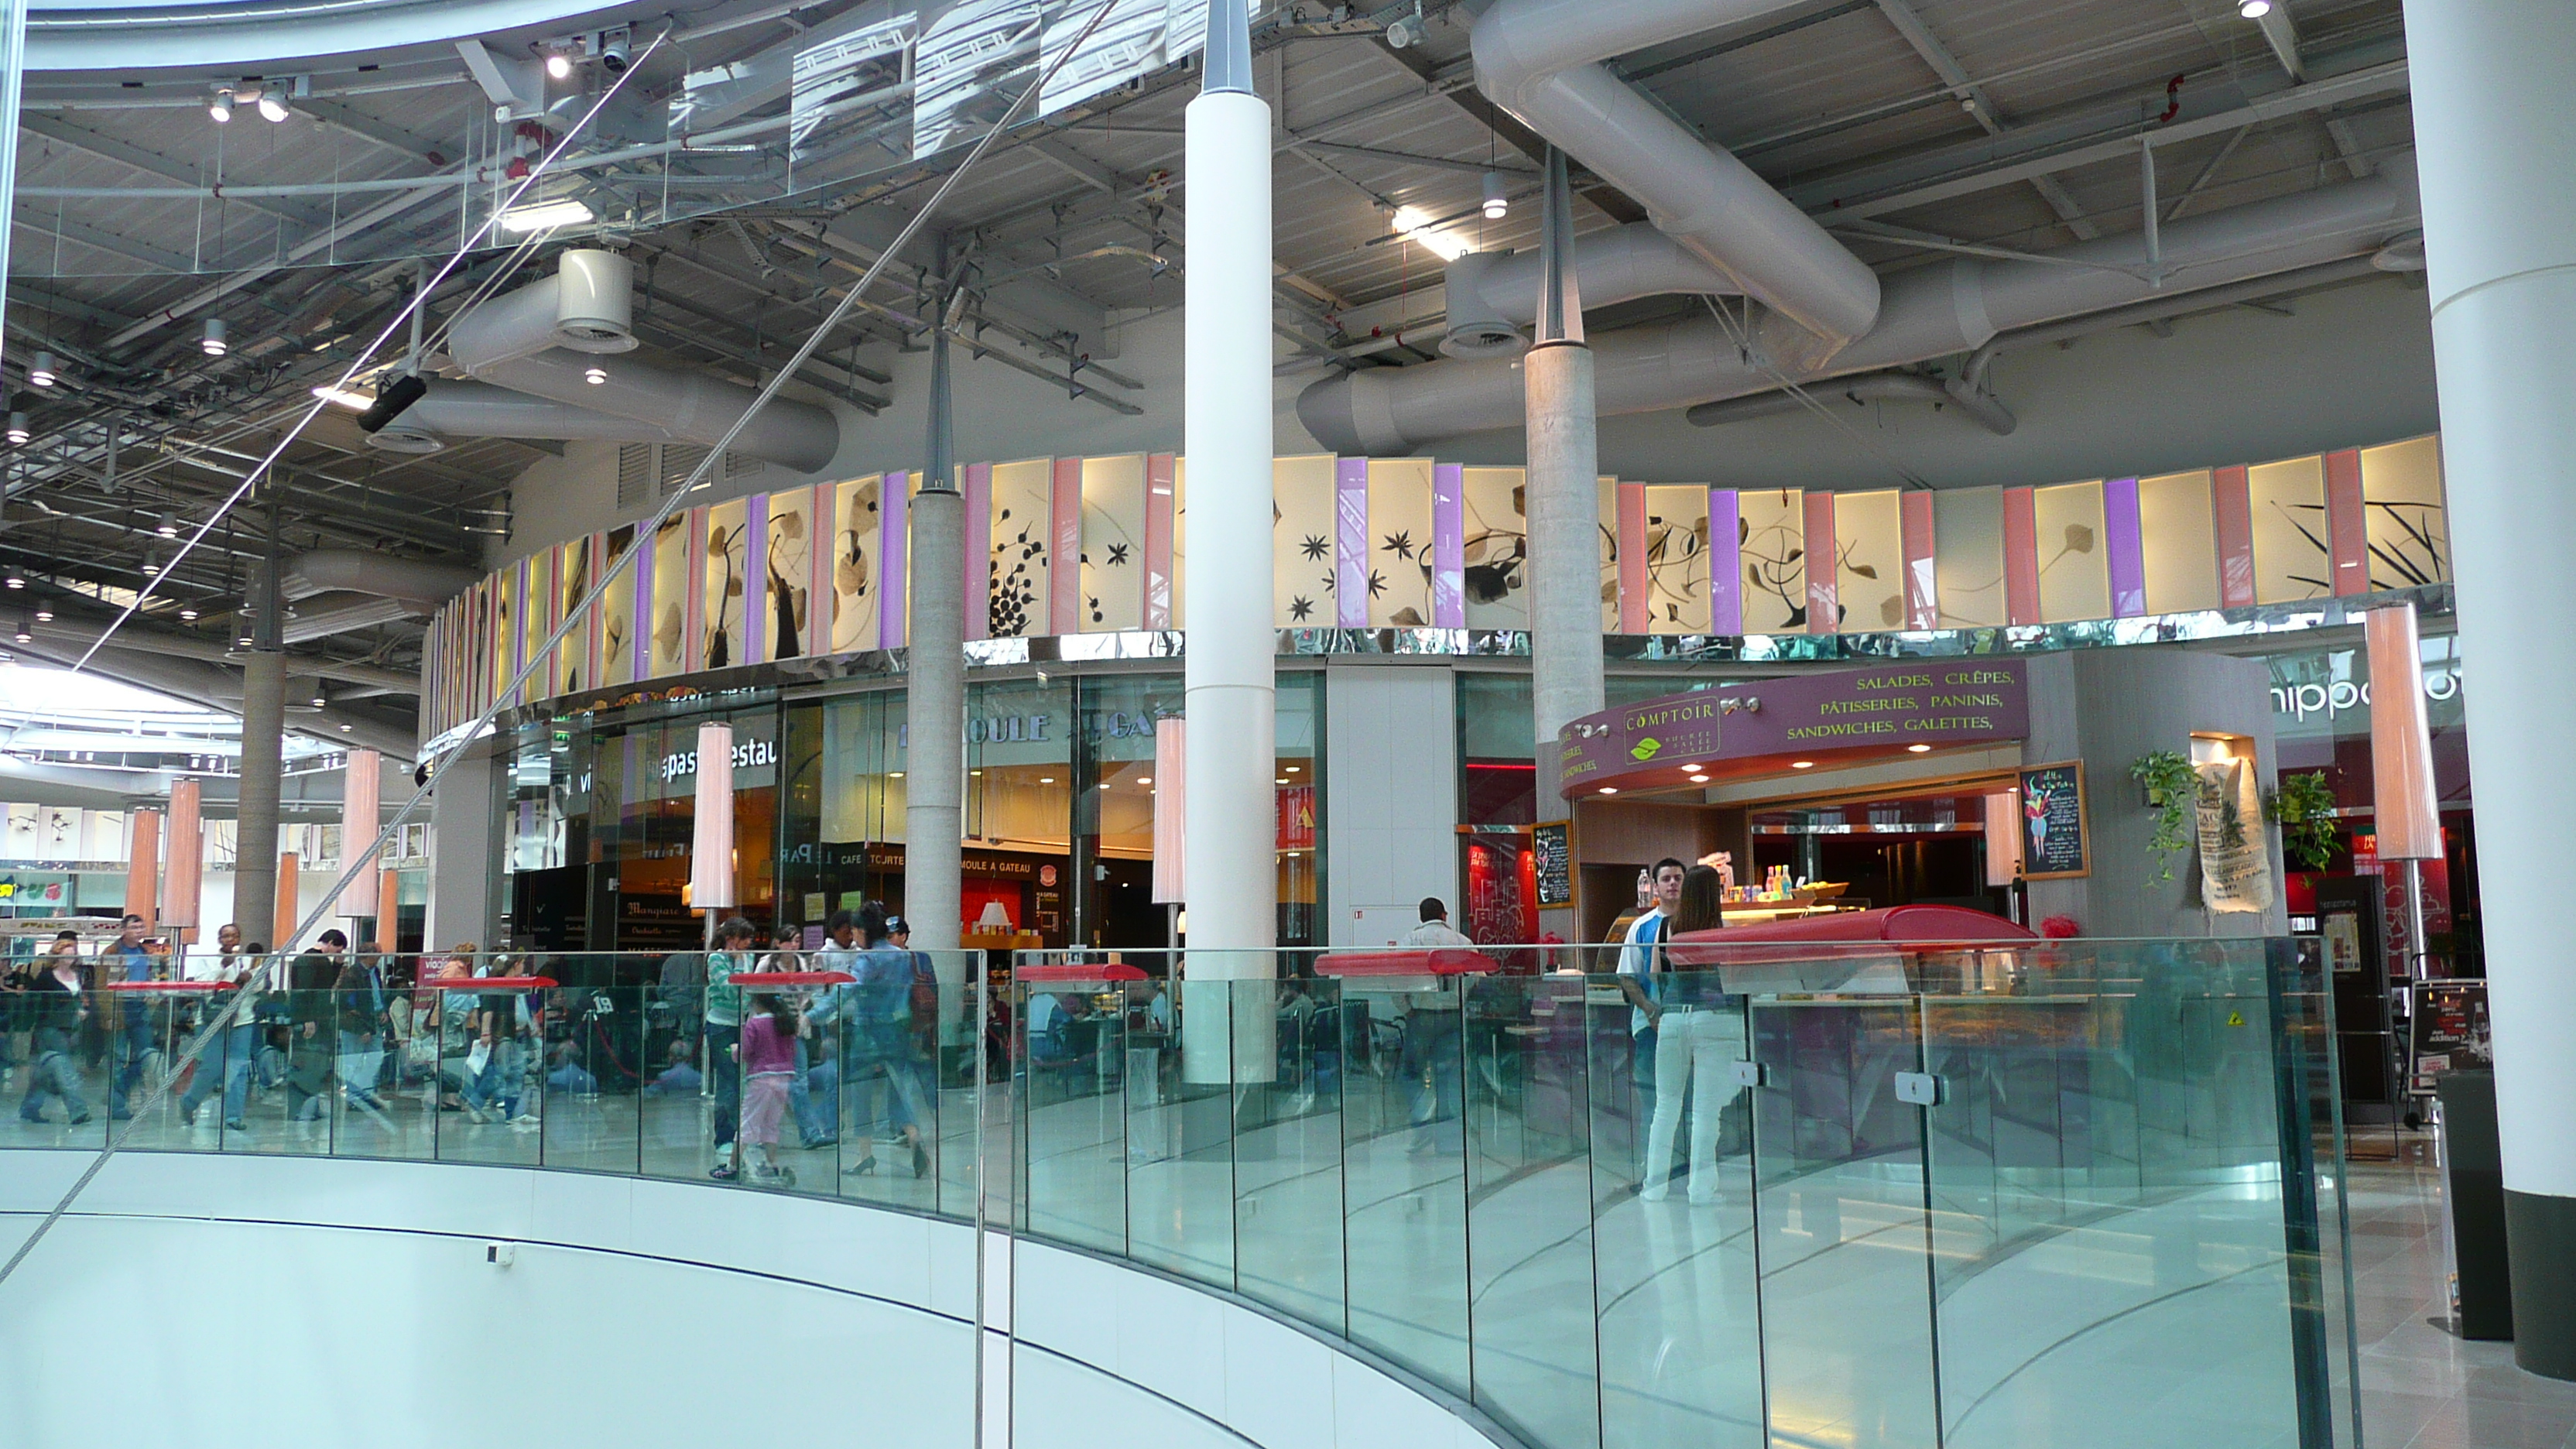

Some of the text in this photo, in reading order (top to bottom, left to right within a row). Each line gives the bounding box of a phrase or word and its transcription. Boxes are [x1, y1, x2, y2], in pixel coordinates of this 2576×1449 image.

[1857, 670, 2015, 690] SALADES, CRÊPES,
[1821, 694, 2003, 715] PÂTISSERIES, PANINIS,
[963, 714, 1051, 745] OULE
[1787, 716, 1993, 740] SANDWICHES, GALETTES,
[999, 862, 1030, 873] GATEAU
